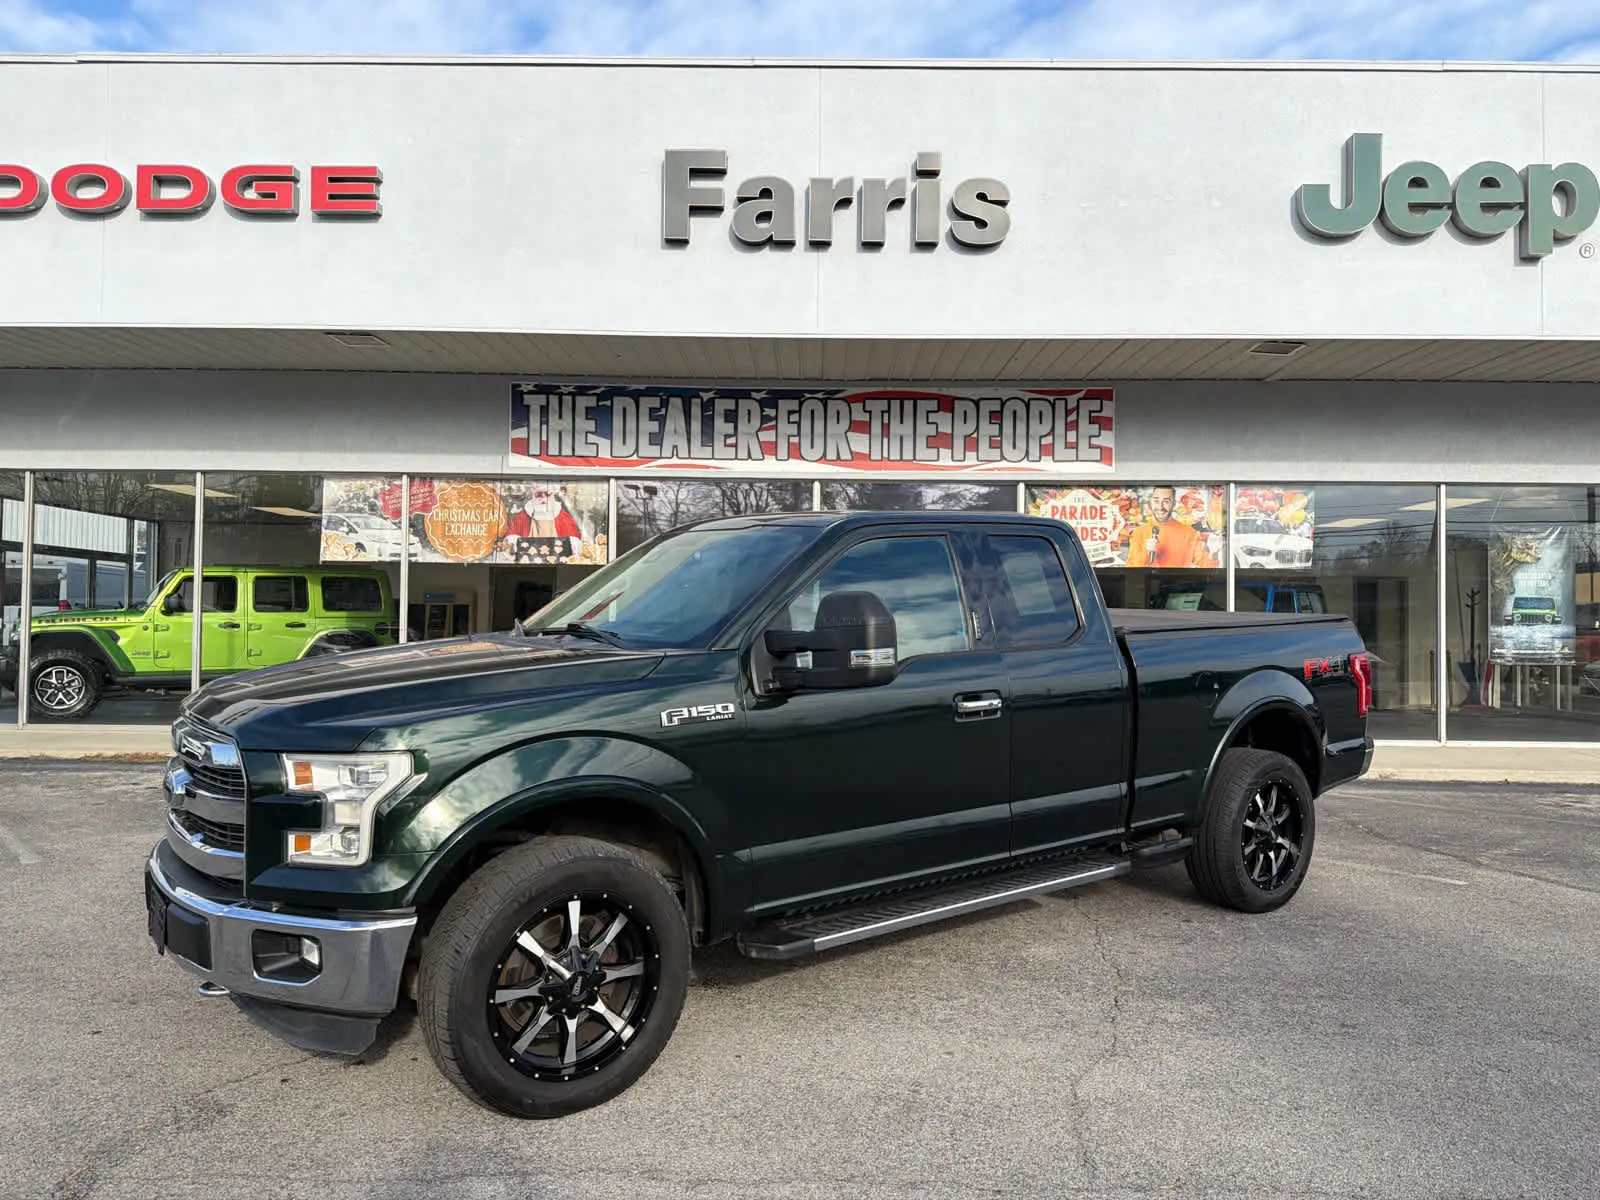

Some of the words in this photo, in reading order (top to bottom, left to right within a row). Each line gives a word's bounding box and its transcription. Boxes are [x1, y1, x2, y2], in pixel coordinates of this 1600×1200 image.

[0, 163, 384, 219] DODGE
[662, 149, 1012, 247] Farris
[1296, 132, 1600, 257] Jeep
[522, 394, 598, 458] THE
[610, 395, 764, 461] DEALER
[775, 397, 853, 462] FOR
[864, 398, 939, 461] THE
[951, 397, 1103, 462] PEOPLE
[433, 508, 481, 521] CHRISTMAS
[483, 509, 499, 521] CAR
[1050, 504, 1108, 520] PARADE
[445, 523, 488, 536] EXCHANGE
[1304, 656, 1345, 680] FX4
[706, 713, 732, 721] LARIAT
